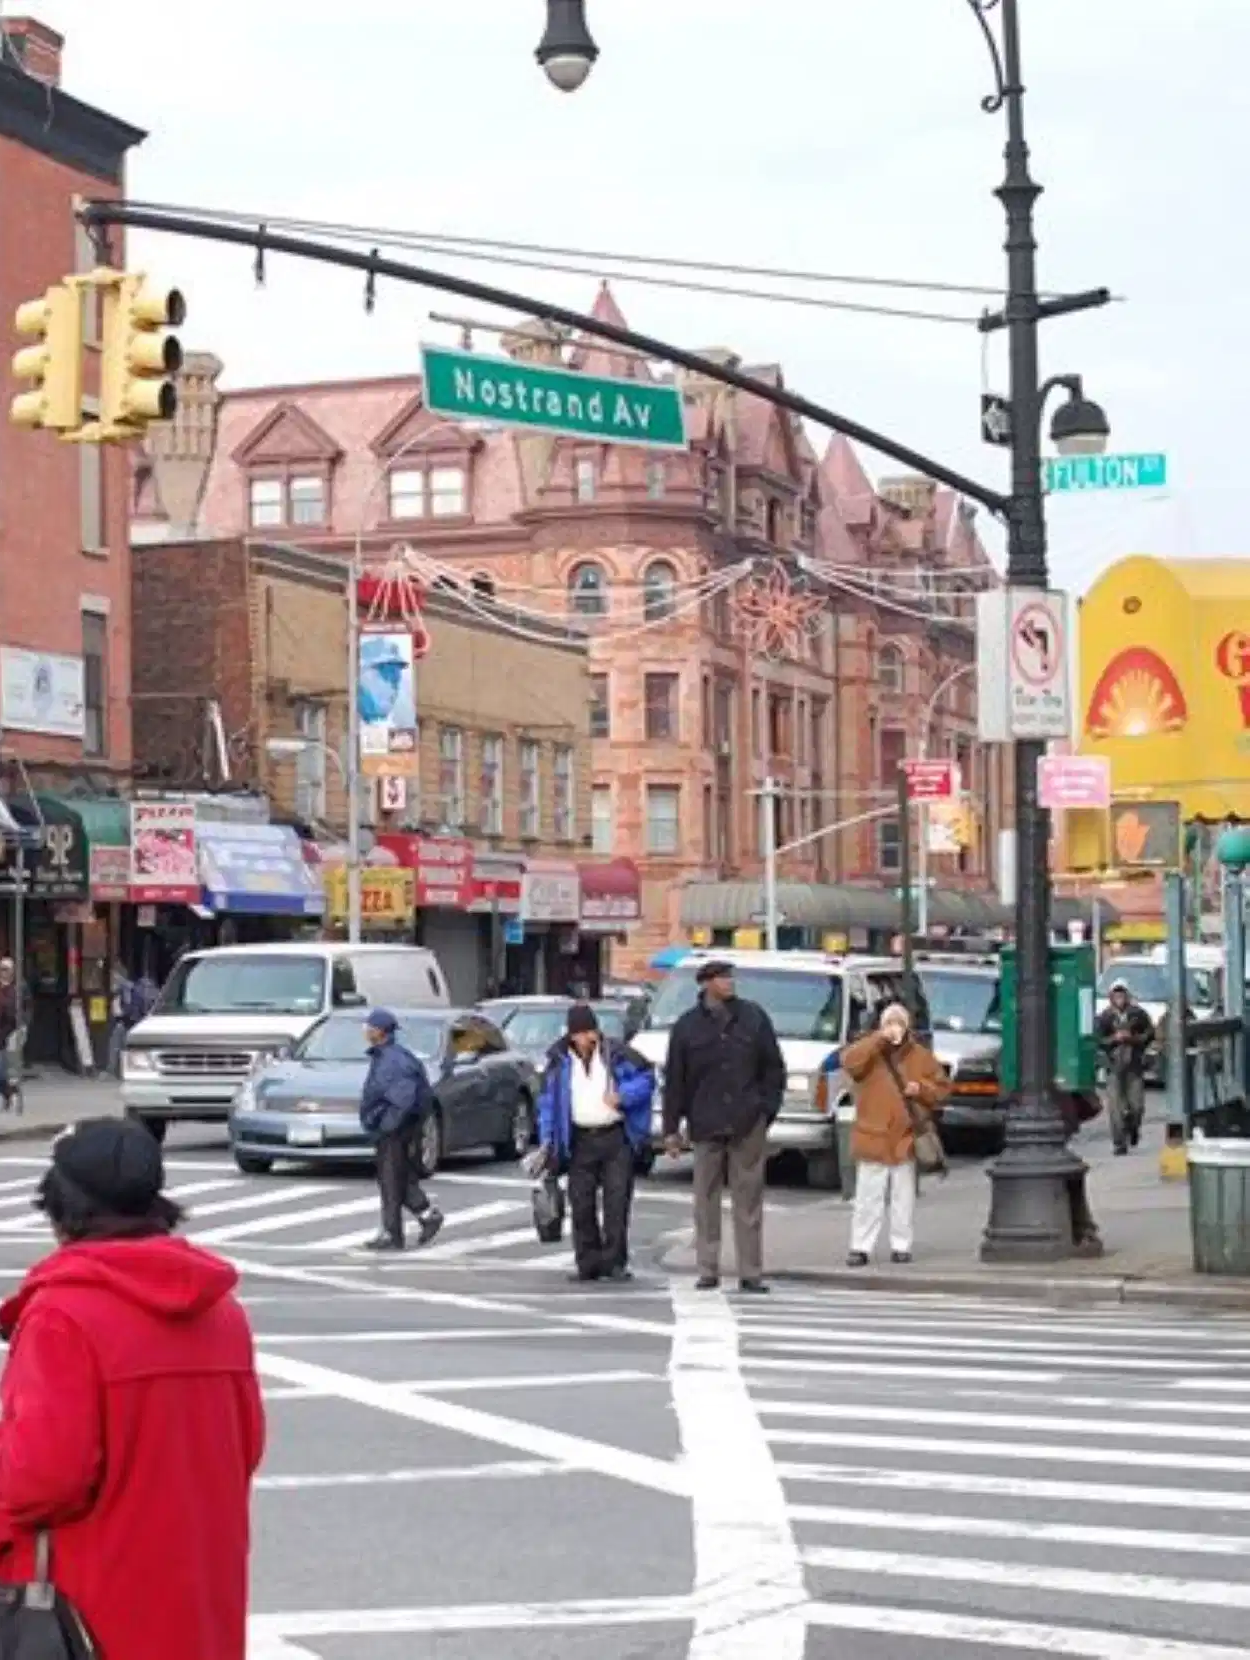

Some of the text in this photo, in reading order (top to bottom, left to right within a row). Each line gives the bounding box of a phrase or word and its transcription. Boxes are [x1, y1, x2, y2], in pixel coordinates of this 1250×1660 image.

[453, 367, 651, 430] Nostrand Av
[1048, 459, 1138, 490] FULTON
